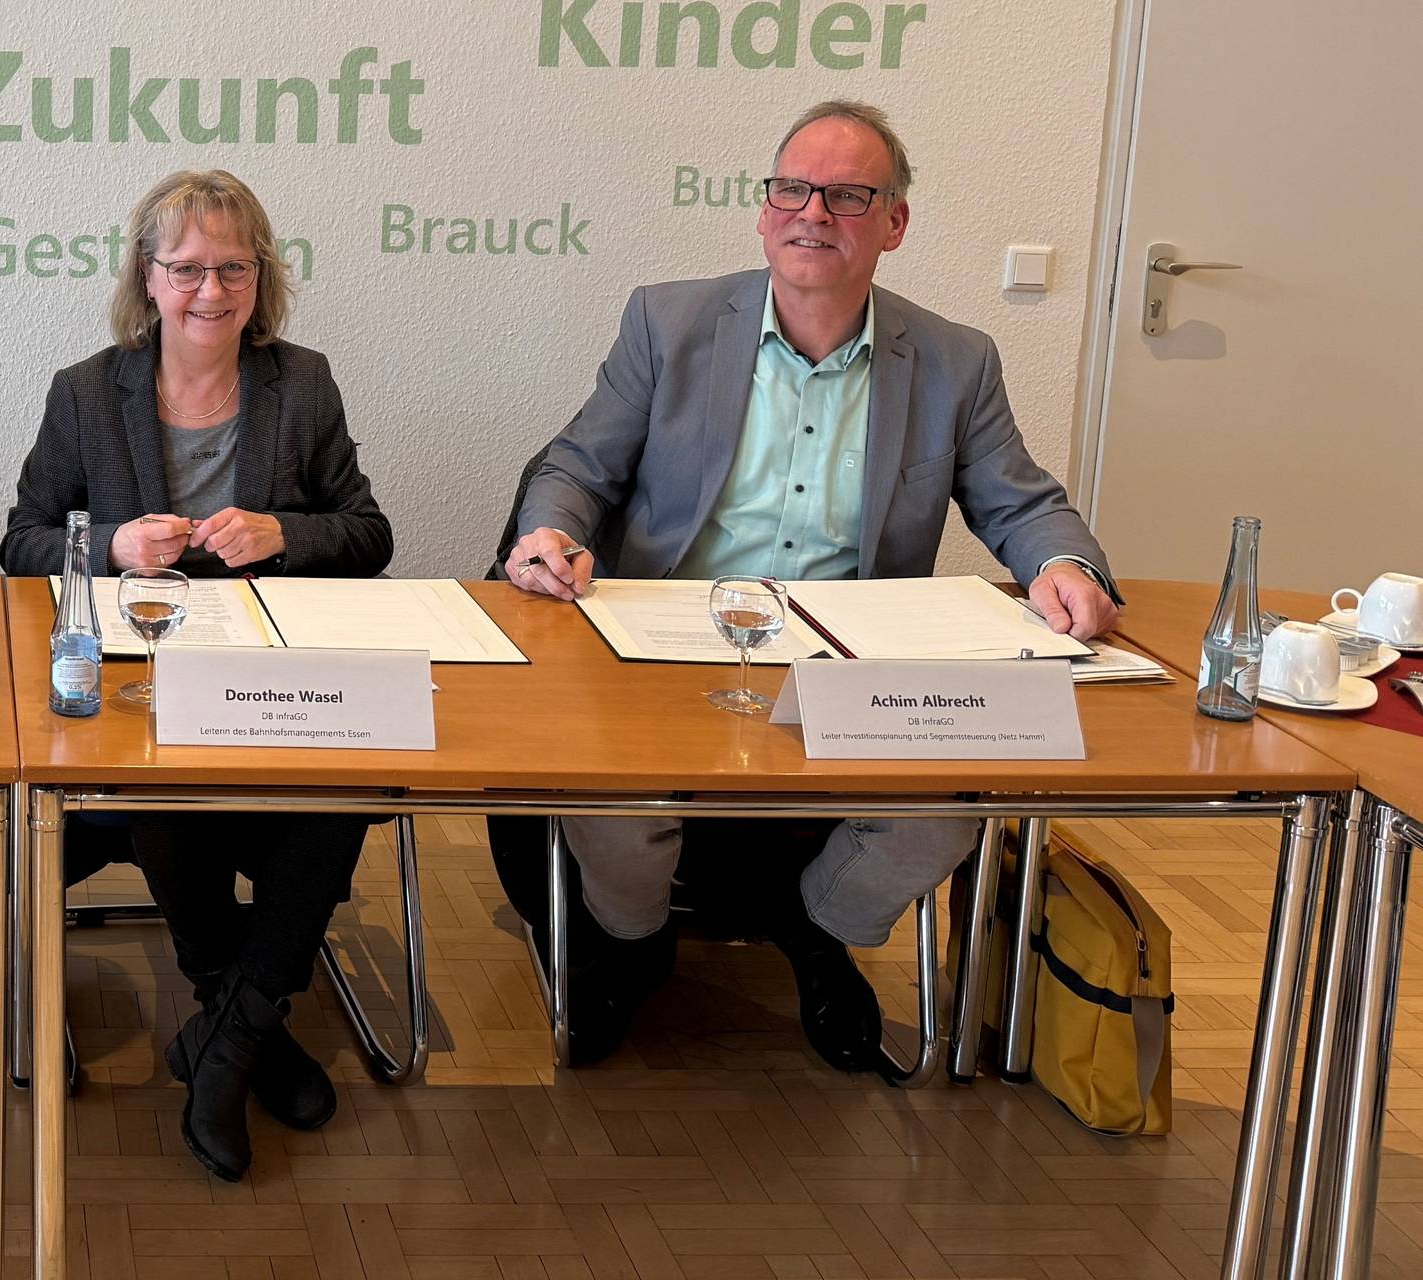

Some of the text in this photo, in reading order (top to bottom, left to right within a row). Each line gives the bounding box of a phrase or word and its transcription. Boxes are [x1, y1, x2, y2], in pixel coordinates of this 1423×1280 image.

[538, 0, 927, 70] Kinder
[380, 203, 591, 256] Brauck
[225, 689, 343, 703] Dorothee Wasel
[871, 695, 986, 707] Achim Albrecht
[261, 712, 274, 721] DB
[908, 717, 920, 726] DB
[200, 727, 371, 739] Leiterin des Bahnhofsmanagements Essen
